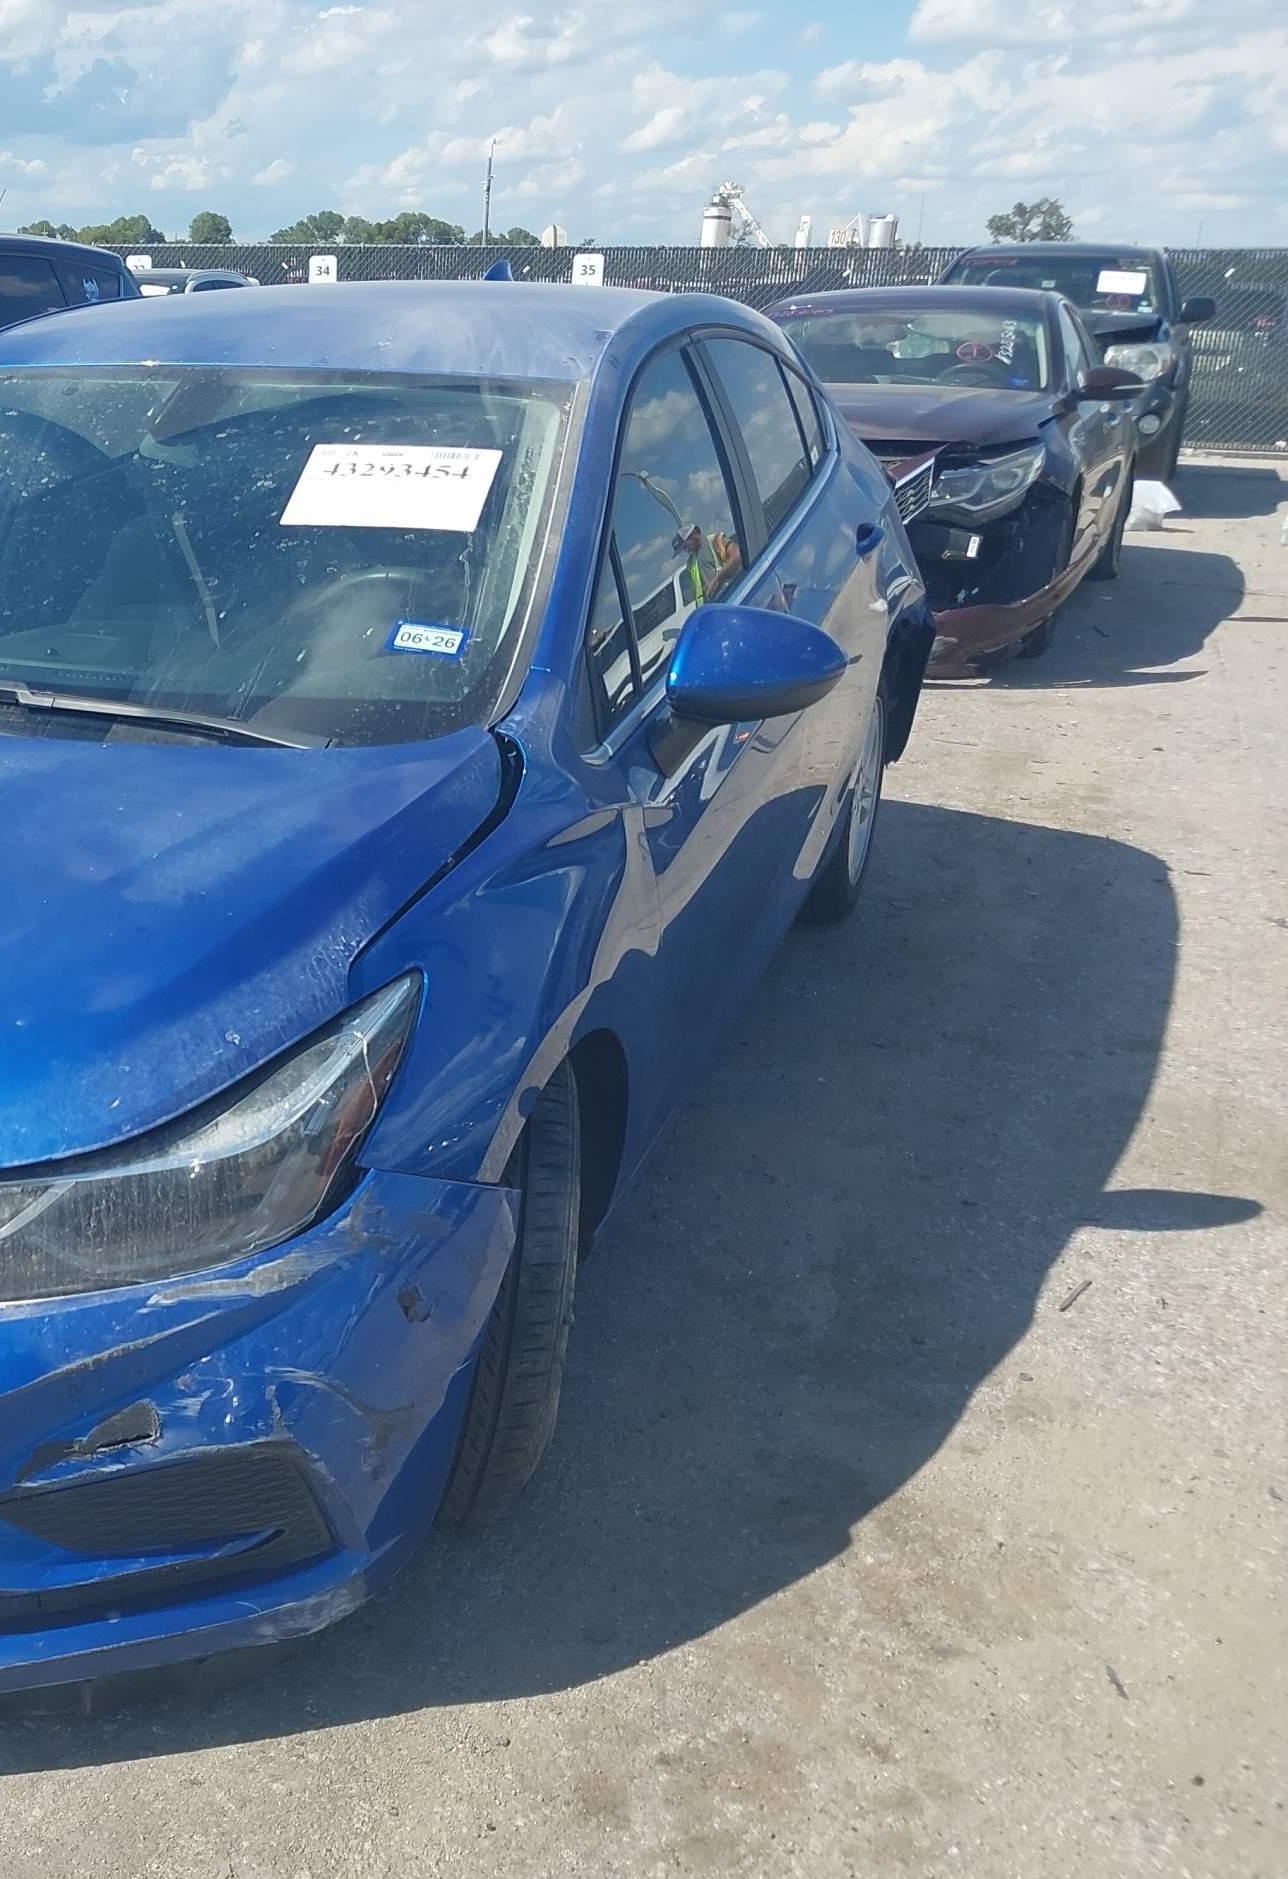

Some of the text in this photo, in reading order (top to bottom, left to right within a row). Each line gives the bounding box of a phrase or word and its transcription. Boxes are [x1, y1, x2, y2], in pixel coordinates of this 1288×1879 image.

[831, 230, 847, 245] 130
[315, 265, 330, 276] 34
[580, 264, 596, 276] 35
[323, 462, 470, 480] 43293454
